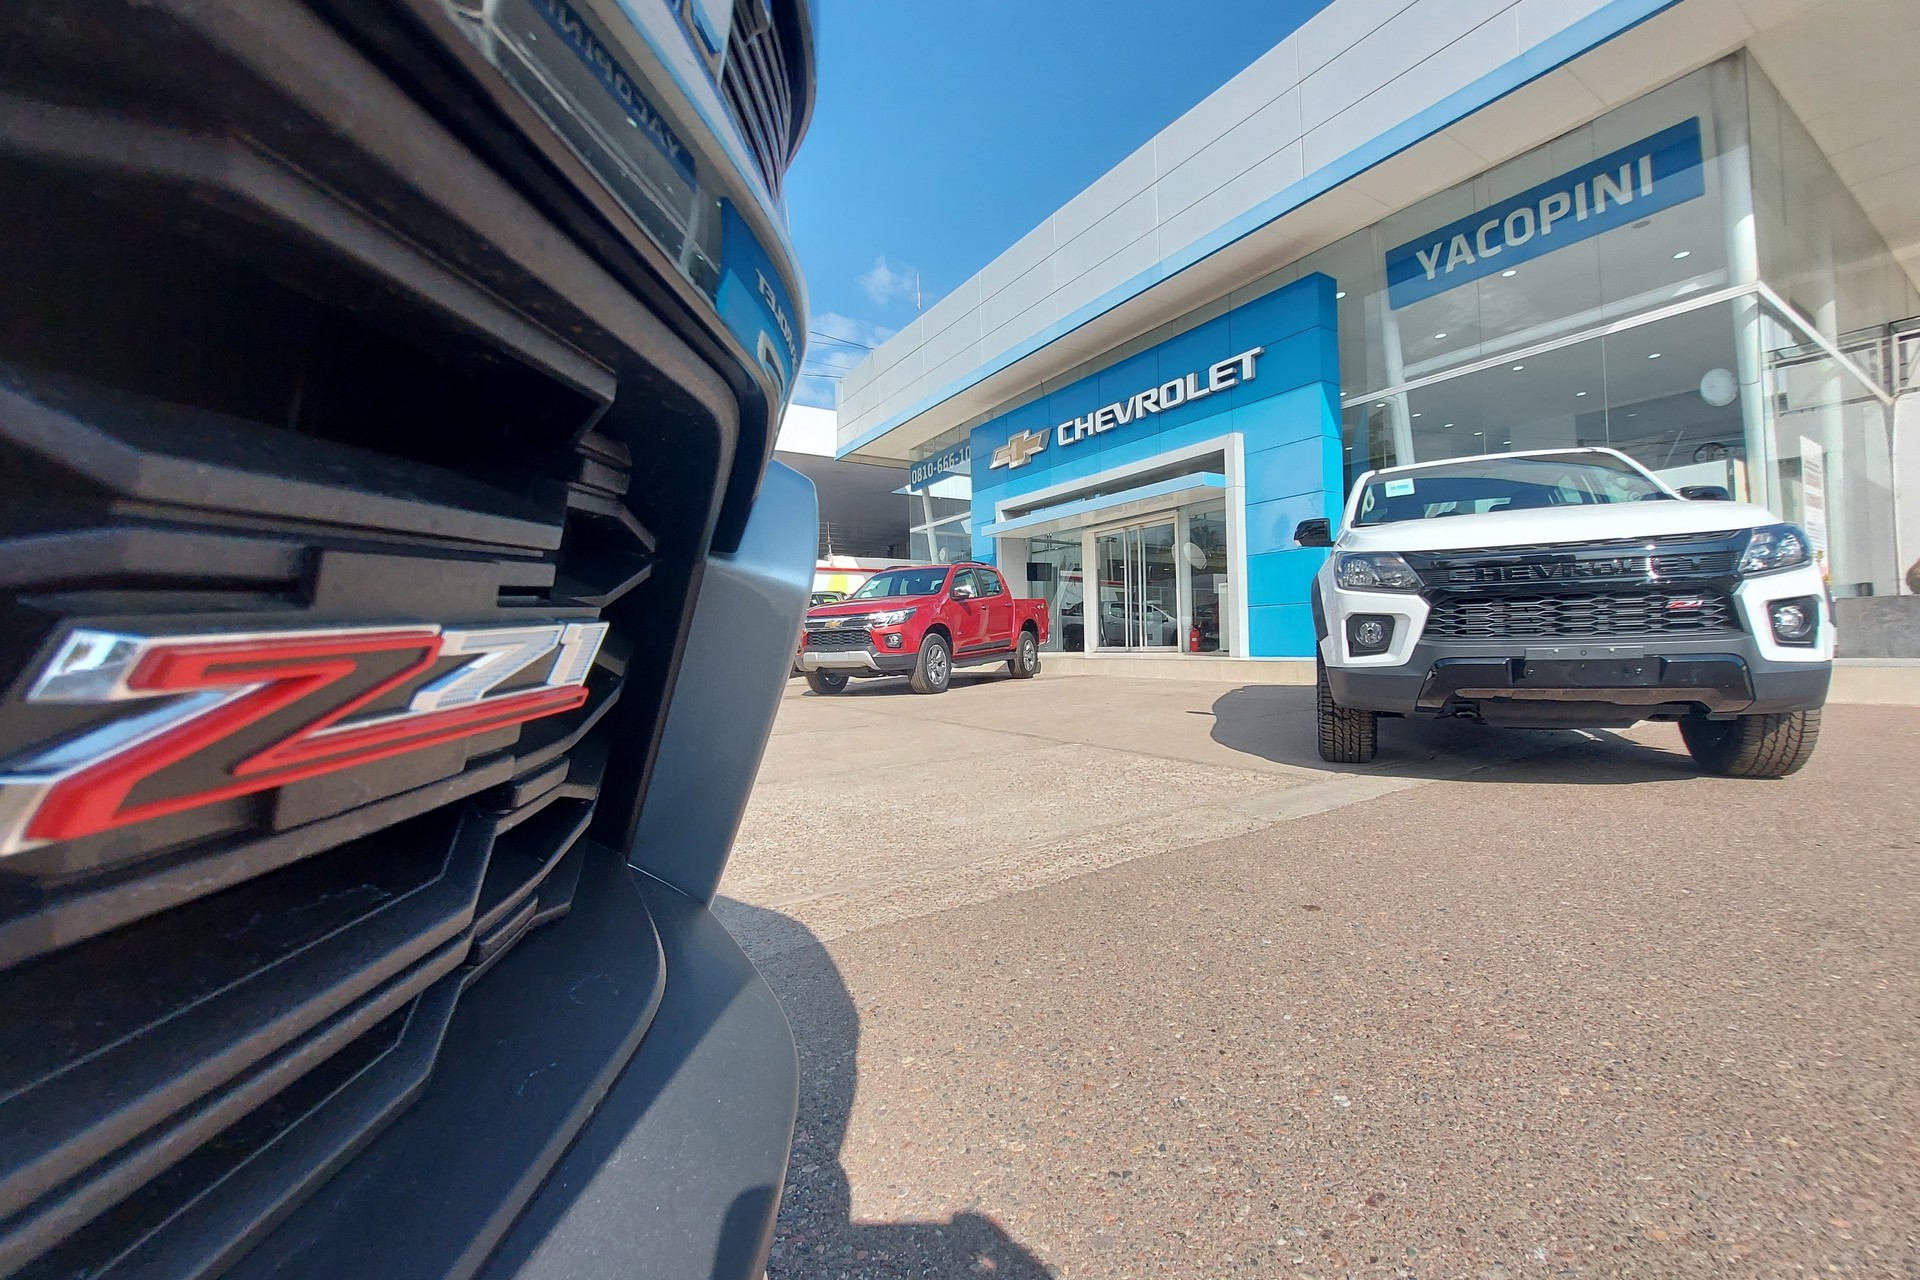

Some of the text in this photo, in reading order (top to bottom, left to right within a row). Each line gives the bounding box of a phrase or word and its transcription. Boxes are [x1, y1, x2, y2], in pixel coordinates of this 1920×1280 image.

[1415, 153, 1655, 281] YACOPINI
[1056, 346, 1264, 447] CHEVROLET
[1449, 556, 1698, 582] CHEVROLET
[0, 621, 610, 858] Z71
